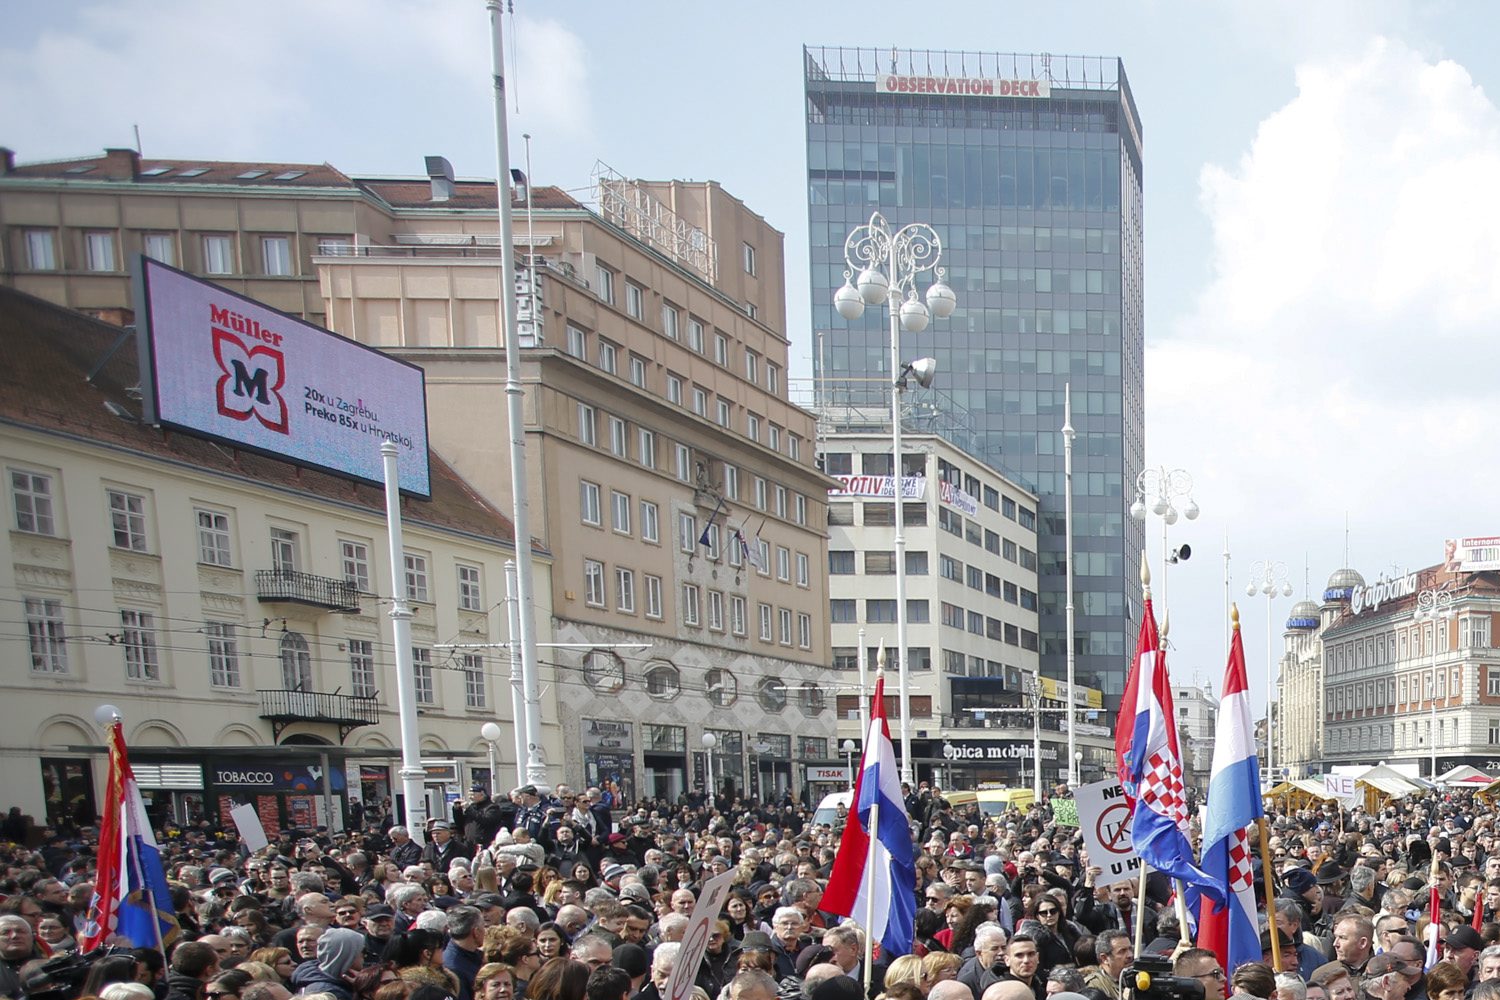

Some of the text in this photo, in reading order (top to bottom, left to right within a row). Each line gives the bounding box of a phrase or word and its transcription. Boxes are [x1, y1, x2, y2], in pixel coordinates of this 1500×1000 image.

[885, 75, 1041, 97] OBSERVATION DECK
[210, 303, 283, 348] Müller
[231, 359, 271, 405] M
[304, 386, 380, 422] 20x u Zagrebu.
[304, 402, 415, 451] Preko 85x u Hrvatskoj.
[217, 771, 274, 783] TOBACCO
[817, 770, 843, 778] TISAK
[1102, 785, 1124, 800] NE
[1326, 777, 1353, 795] NE
[1111, 857, 1142, 875] U H
